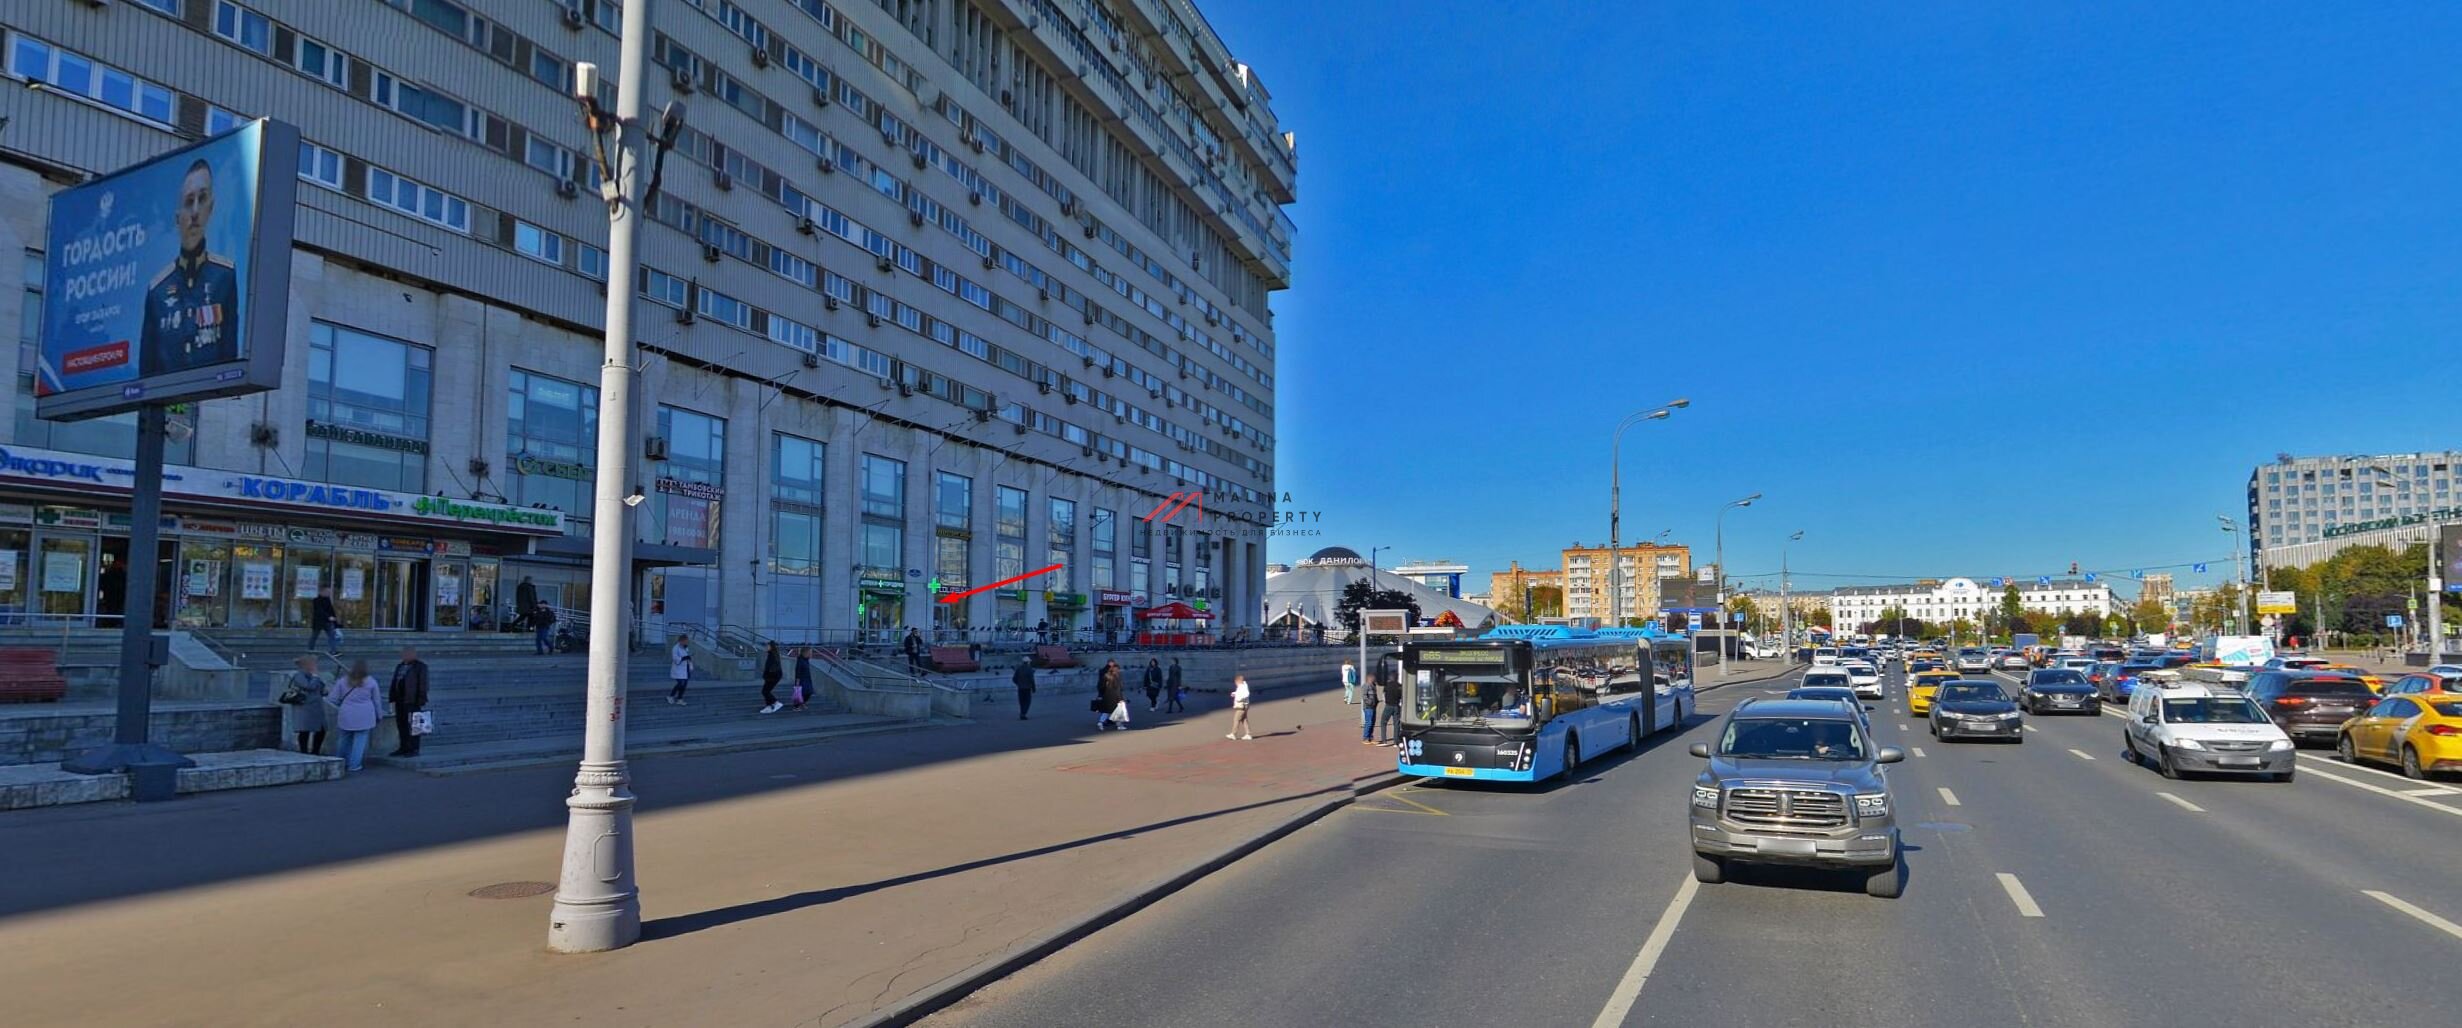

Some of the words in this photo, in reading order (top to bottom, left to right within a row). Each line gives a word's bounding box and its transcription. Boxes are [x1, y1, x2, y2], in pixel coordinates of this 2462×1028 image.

[62, 222, 146, 268] ГОРДОСТЬ
[65, 261, 137, 302] РОССИИ!
[241, 476, 390, 511] КОРАБЛЬ
